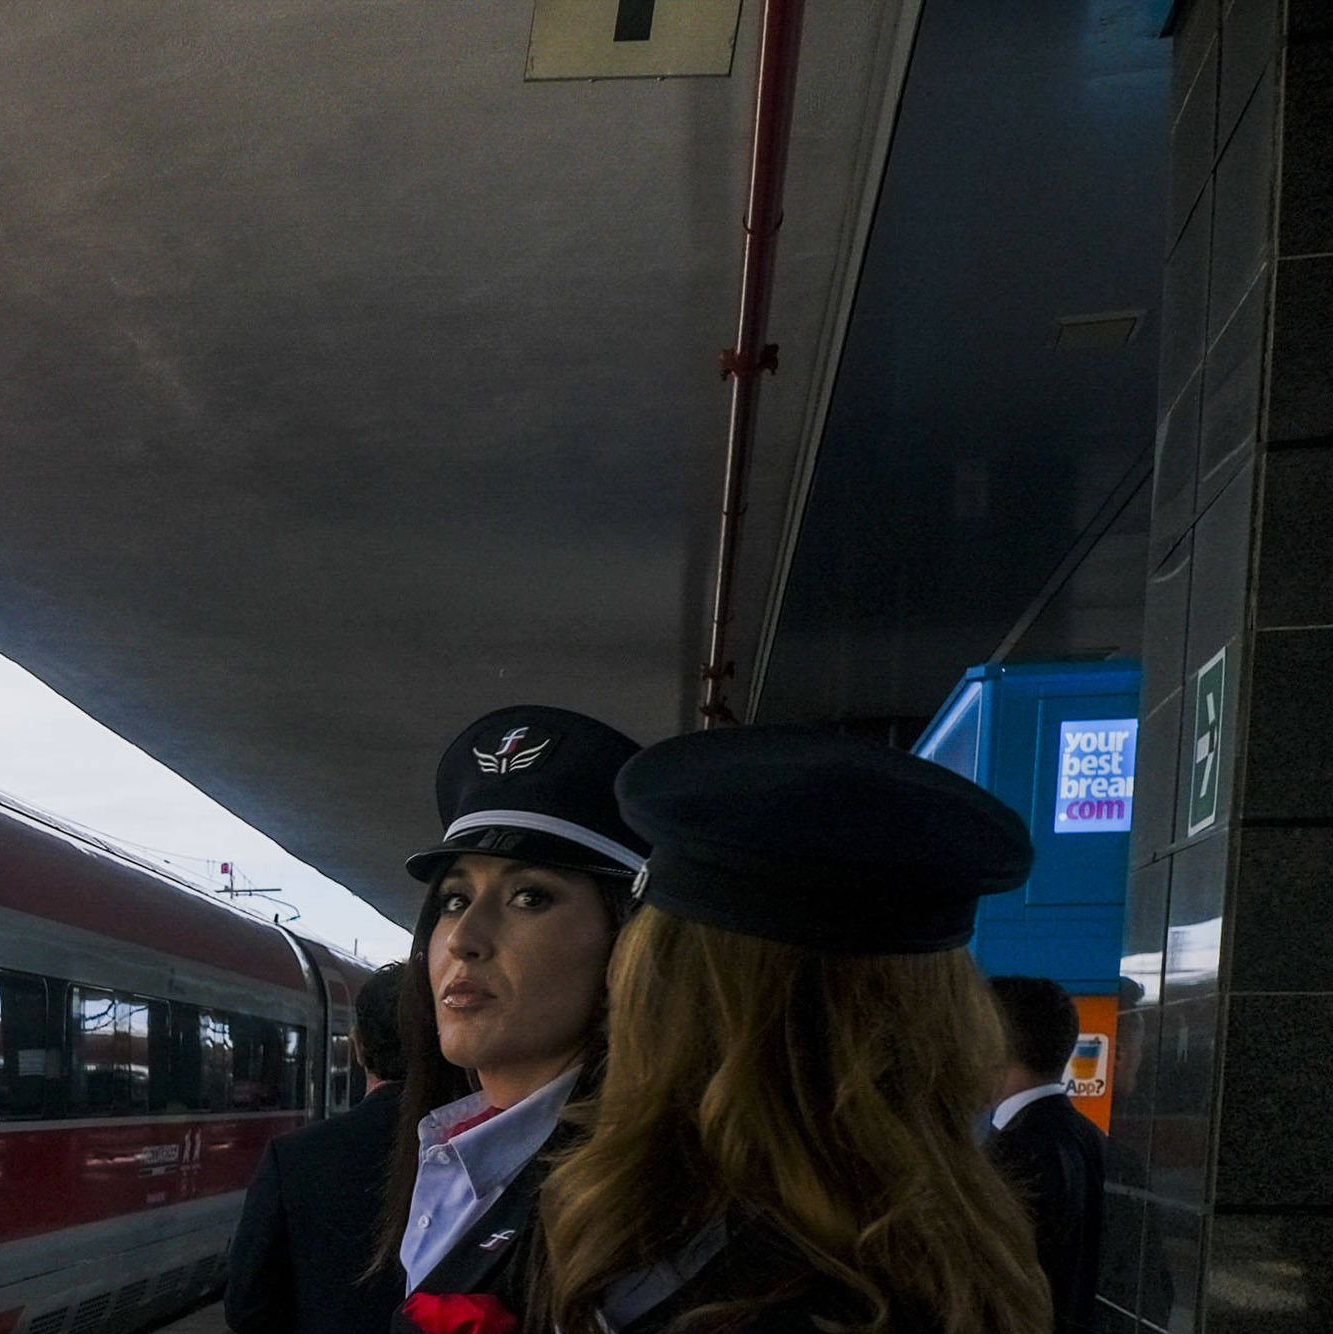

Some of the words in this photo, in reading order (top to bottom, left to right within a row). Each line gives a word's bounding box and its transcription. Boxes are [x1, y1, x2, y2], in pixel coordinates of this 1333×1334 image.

[1064, 731, 1130, 753] your
[1062, 751, 1124, 776] best
[1058, 800, 1125, 821] .com
[1066, 1079, 1105, 1096] App?
